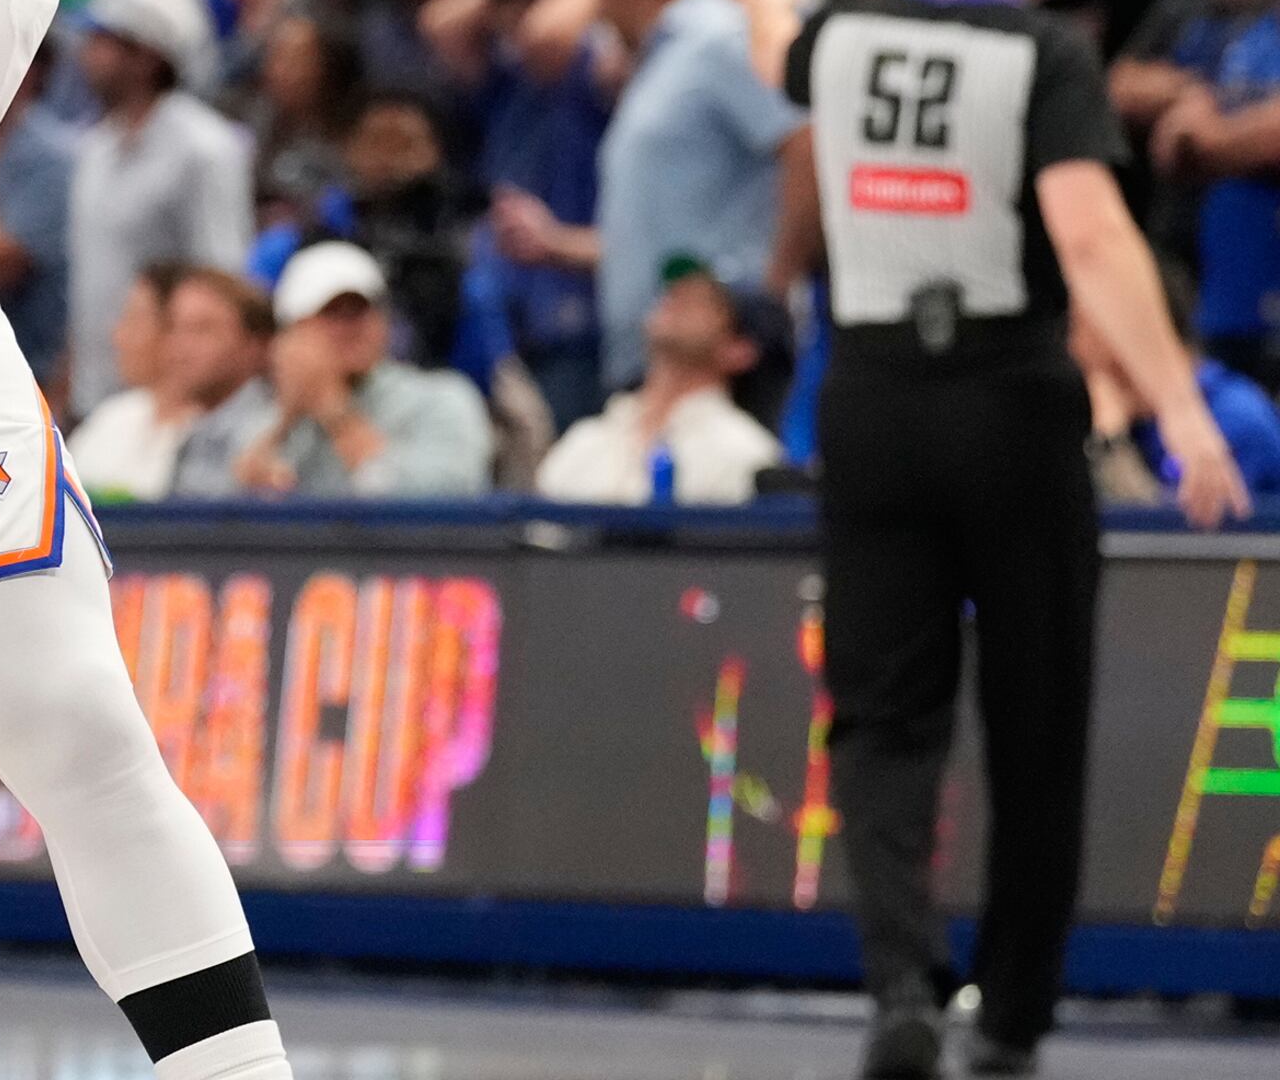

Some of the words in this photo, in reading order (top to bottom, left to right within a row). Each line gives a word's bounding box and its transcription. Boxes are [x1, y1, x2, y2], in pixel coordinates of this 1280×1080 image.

[864, 51, 956, 150] 52
[108, 573, 273, 867] BA
[270, 569, 503, 874] CUP
